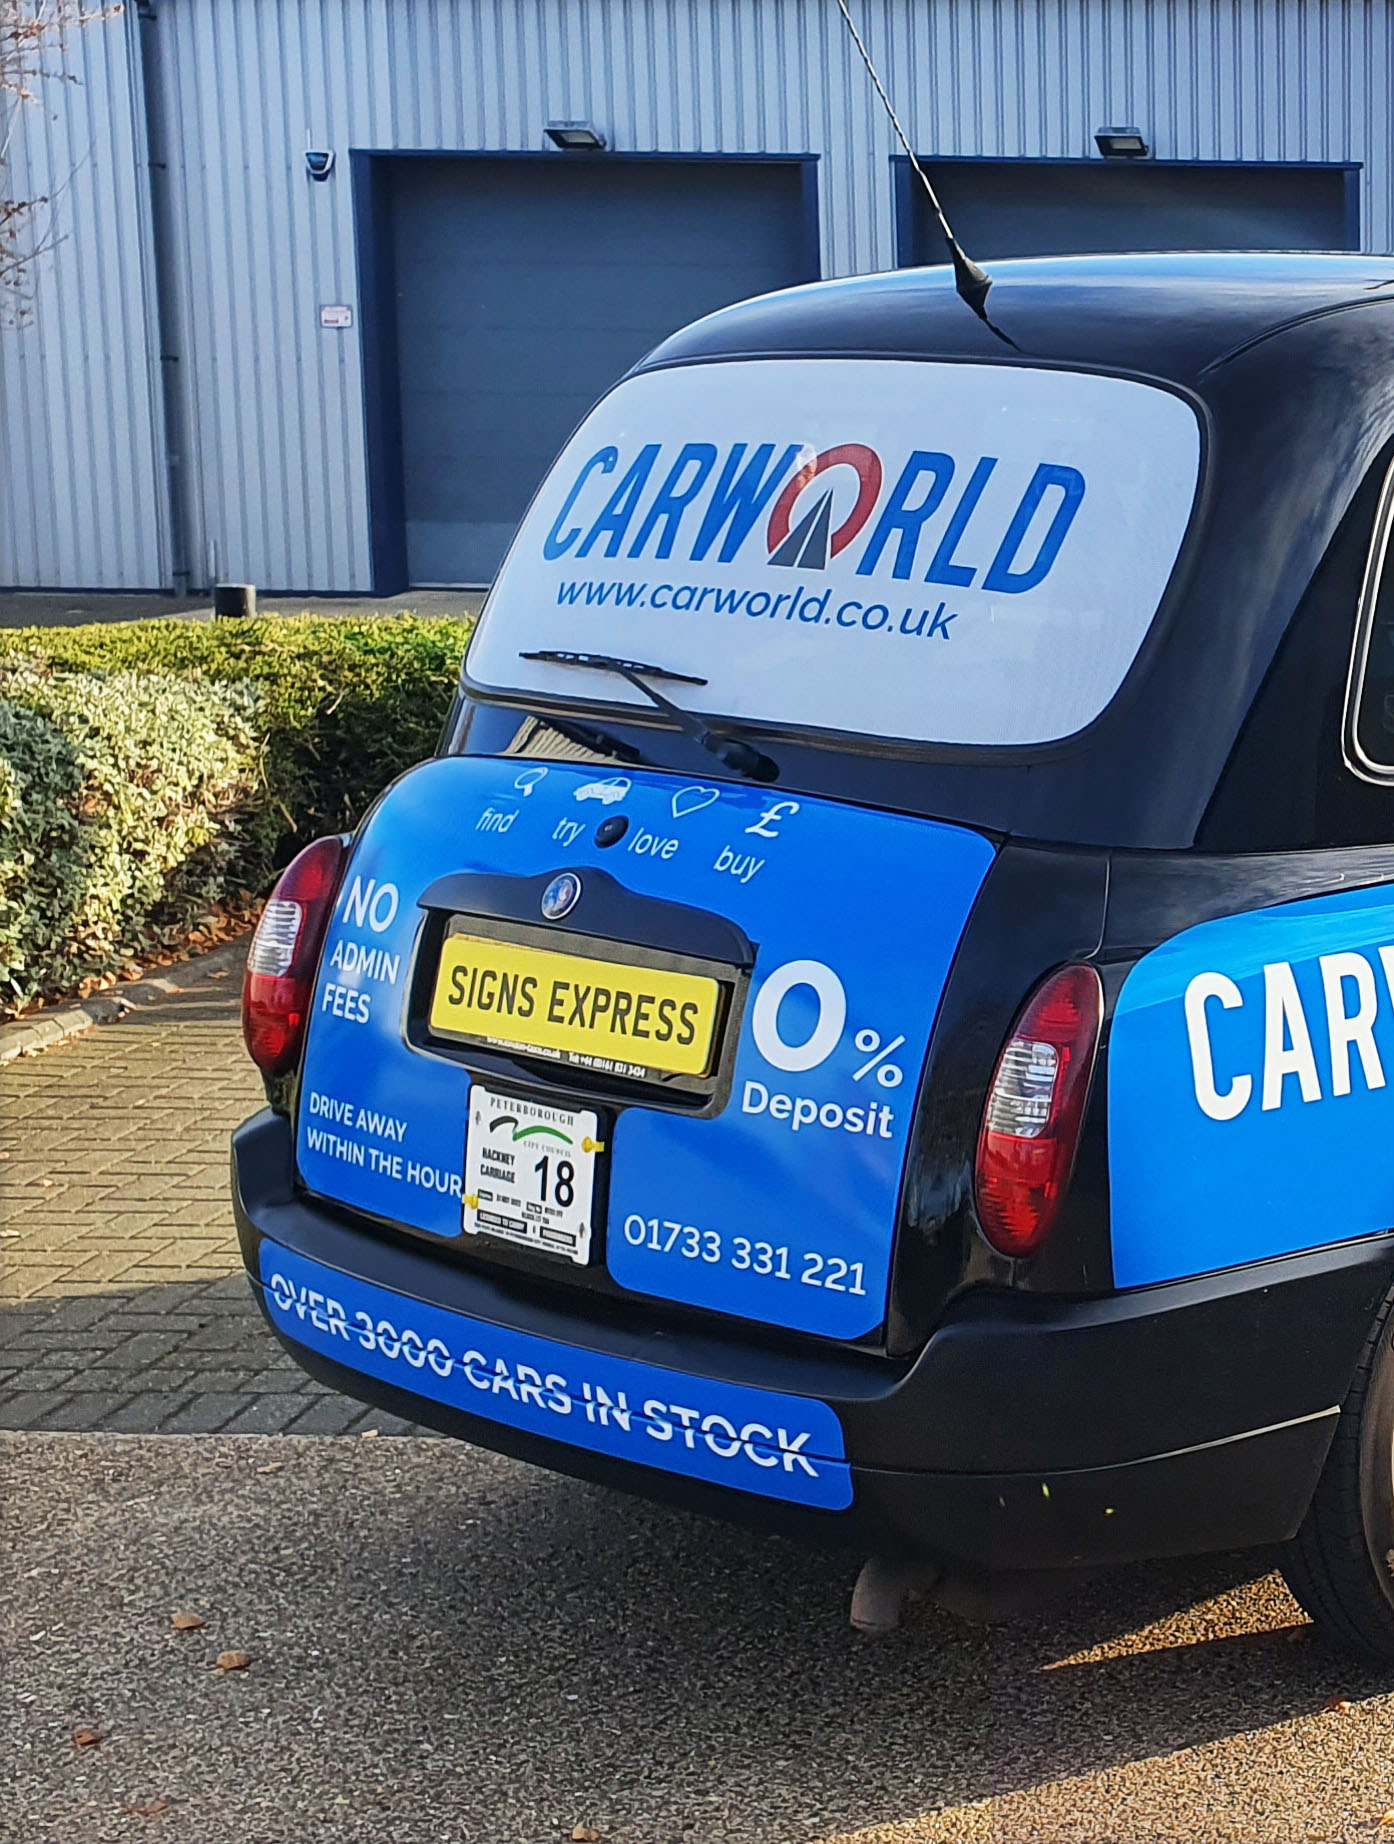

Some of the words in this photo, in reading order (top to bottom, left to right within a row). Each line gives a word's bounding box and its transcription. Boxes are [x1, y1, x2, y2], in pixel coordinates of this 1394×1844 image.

[542, 443, 1086, 594] CARWORLD
[557, 577, 958, 640] www.carworld.co.uk
[474, 807, 519, 833] find
[552, 817, 586, 847] try
[628, 827, 679, 860] love
[713, 845, 765, 884] buy
[342, 875, 399, 933] NO
[330, 940, 400, 984] ADMIN
[321, 983, 371, 1024] FEES
[448, 965, 539, 1017] SIGNS
[547, 981, 699, 1045] EXPRESS
[309, 1091, 353, 1126] DRIVE
[356, 1108, 407, 1143] AWAY
[490, 1097, 574, 1126] PETERBOROUGH
[741, 1080, 894, 1138] Deposit
[306, 1126, 364, 1167] WITHIN
[368, 1147, 402, 1180] THE
[407, 1162, 463, 1199] HOUR
[480, 1164, 515, 1184] CARRIAGE
[482, 1147, 515, 1166] HACKNEY
[534, 1155, 575, 1208] 18
[624, 1214, 721, 1263] 01733
[731, 1237, 791, 1280] 331
[801, 1253, 866, 1296] 221
[270, 1273, 350, 1341] OVER
[357, 1311, 453, 1377] 3000
[462, 1349, 572, 1415] CARS
[582, 1382, 633, 1432] IN
[644, 1398, 819, 1478] STOCK
